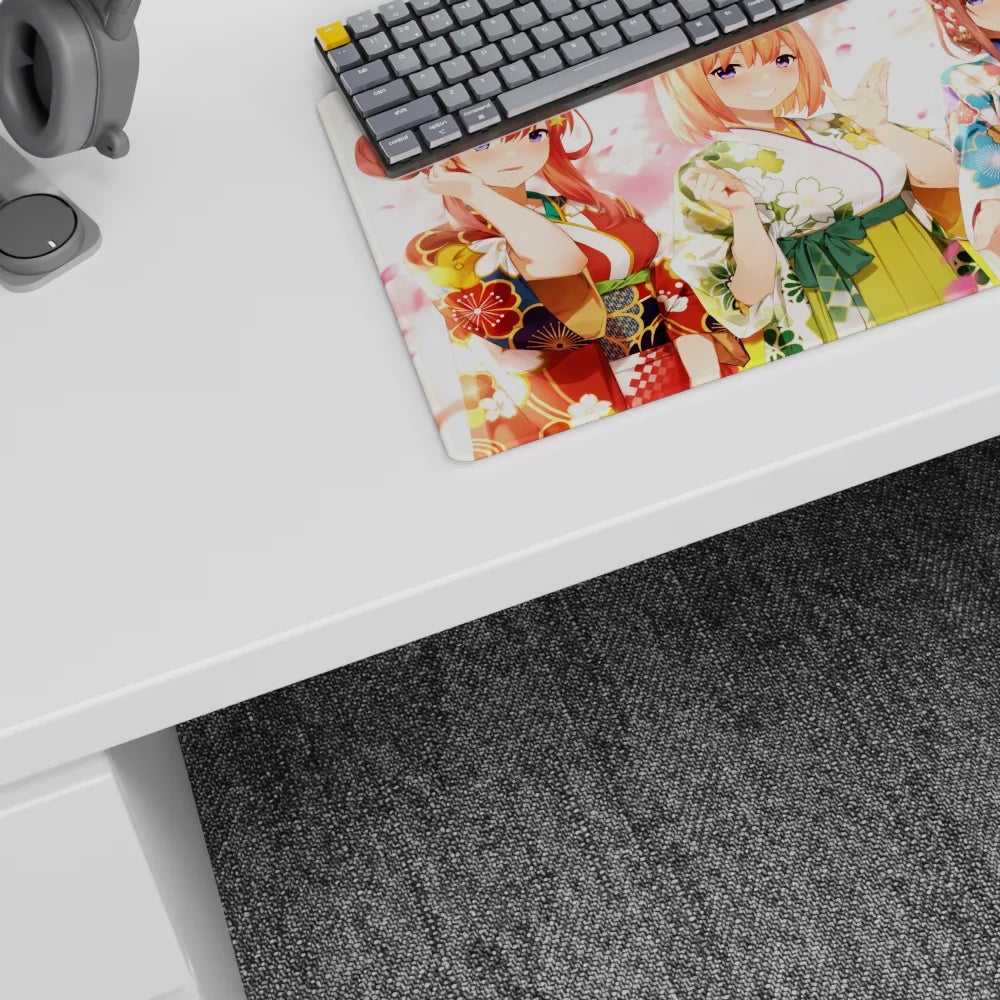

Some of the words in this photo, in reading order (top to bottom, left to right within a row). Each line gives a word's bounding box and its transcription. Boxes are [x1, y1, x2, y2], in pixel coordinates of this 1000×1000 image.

[394, 106, 408, 115] shift
[463, 103, 491, 116] command
[429, 120, 448, 131] option
[388, 134, 409, 146] control
